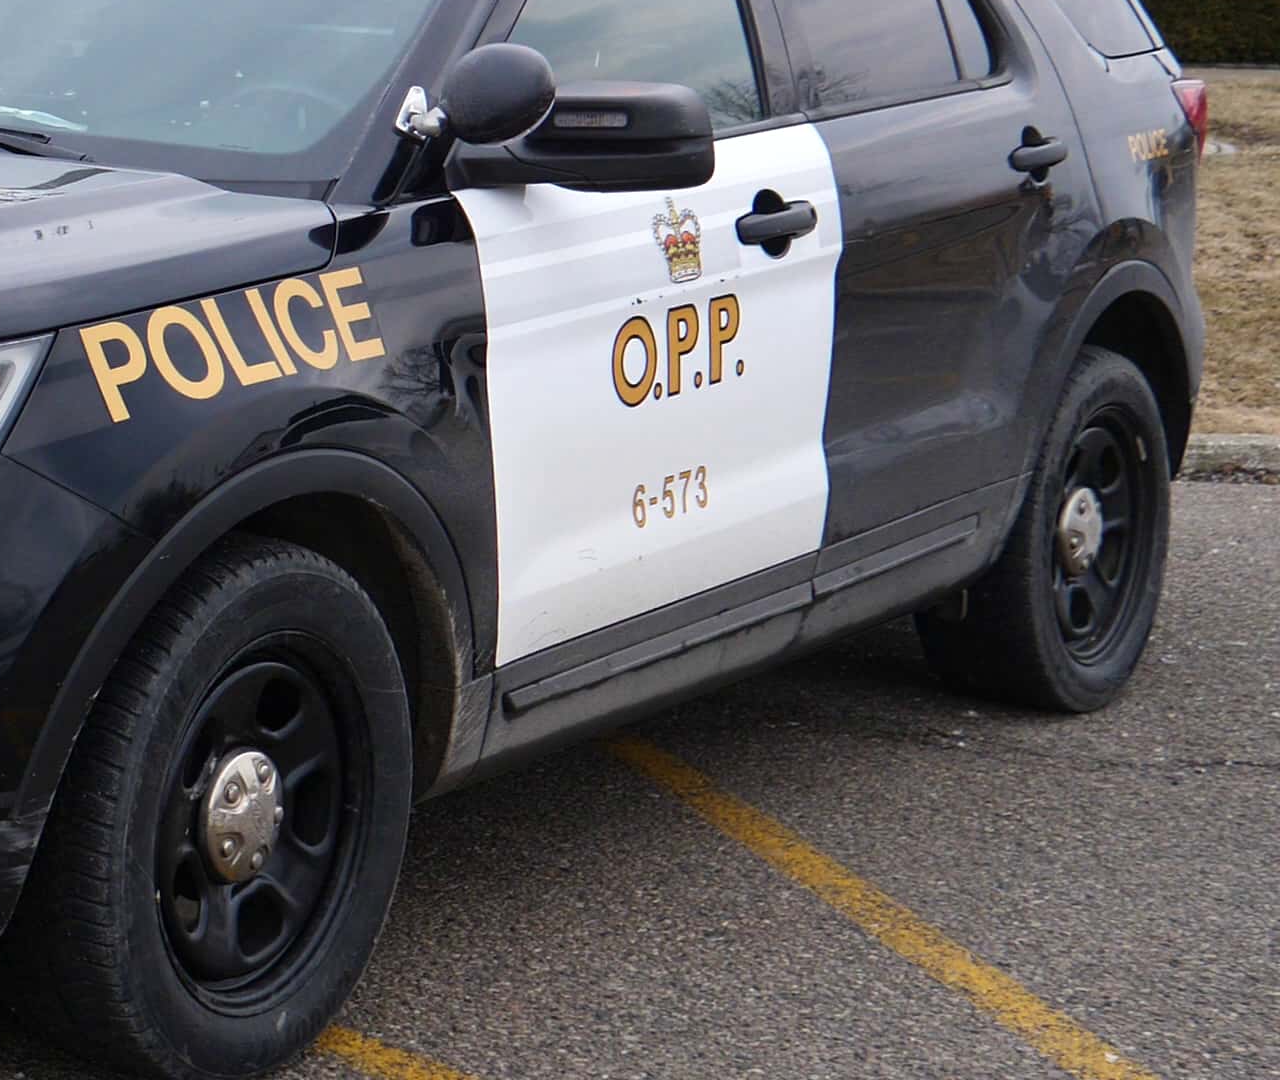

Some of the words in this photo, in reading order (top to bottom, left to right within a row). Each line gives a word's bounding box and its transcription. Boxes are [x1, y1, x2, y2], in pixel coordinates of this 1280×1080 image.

[1127, 128, 1169, 164] POLICE
[78, 266, 387, 423] POLICE
[611, 293, 745, 408] O.P.P.
[632, 465, 709, 529] 6-573
